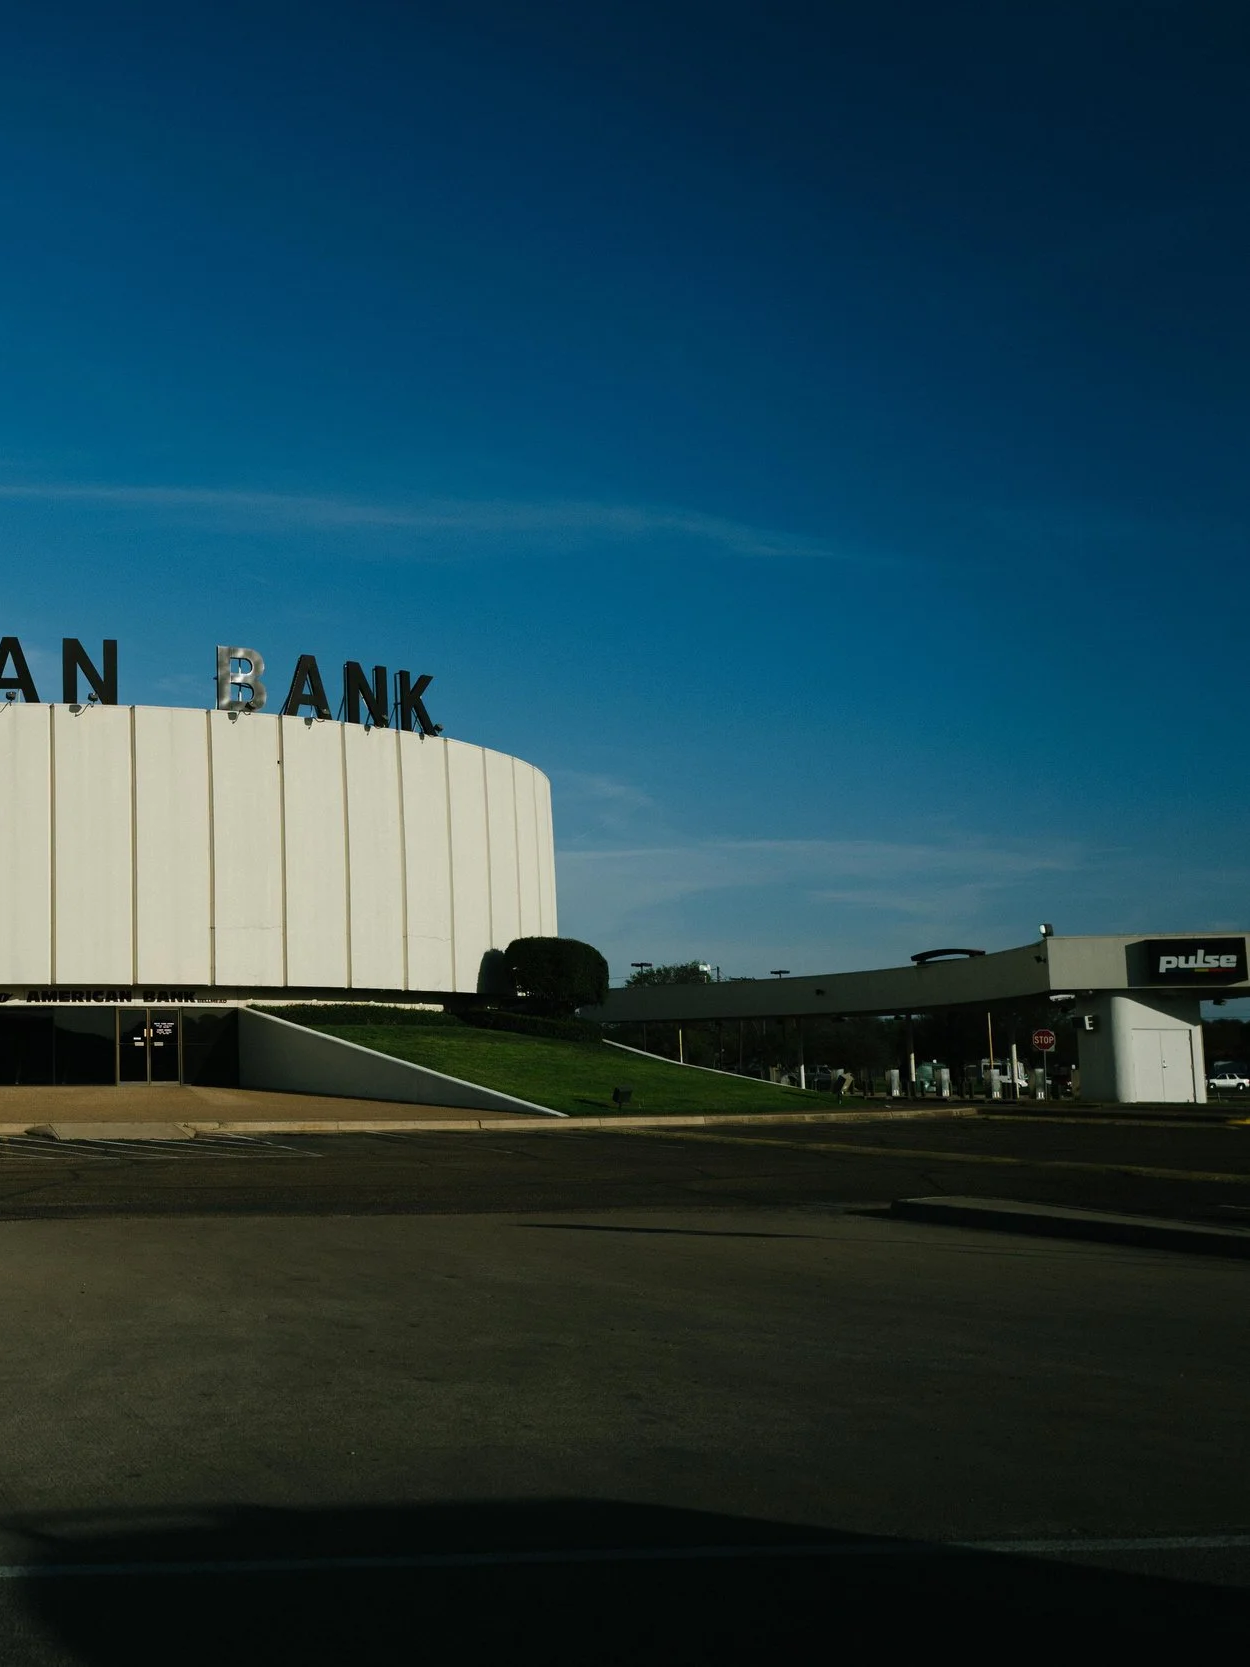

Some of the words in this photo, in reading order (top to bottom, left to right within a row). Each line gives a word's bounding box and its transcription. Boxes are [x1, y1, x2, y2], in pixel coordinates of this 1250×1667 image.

[216, 645, 438, 736] BANK
[1158, 949, 1238, 973] pulse
[26, 990, 132, 1003] AMERICAN
[143, 990, 196, 1003] BANK
[1034, 1035, 1054, 1044] STOP
